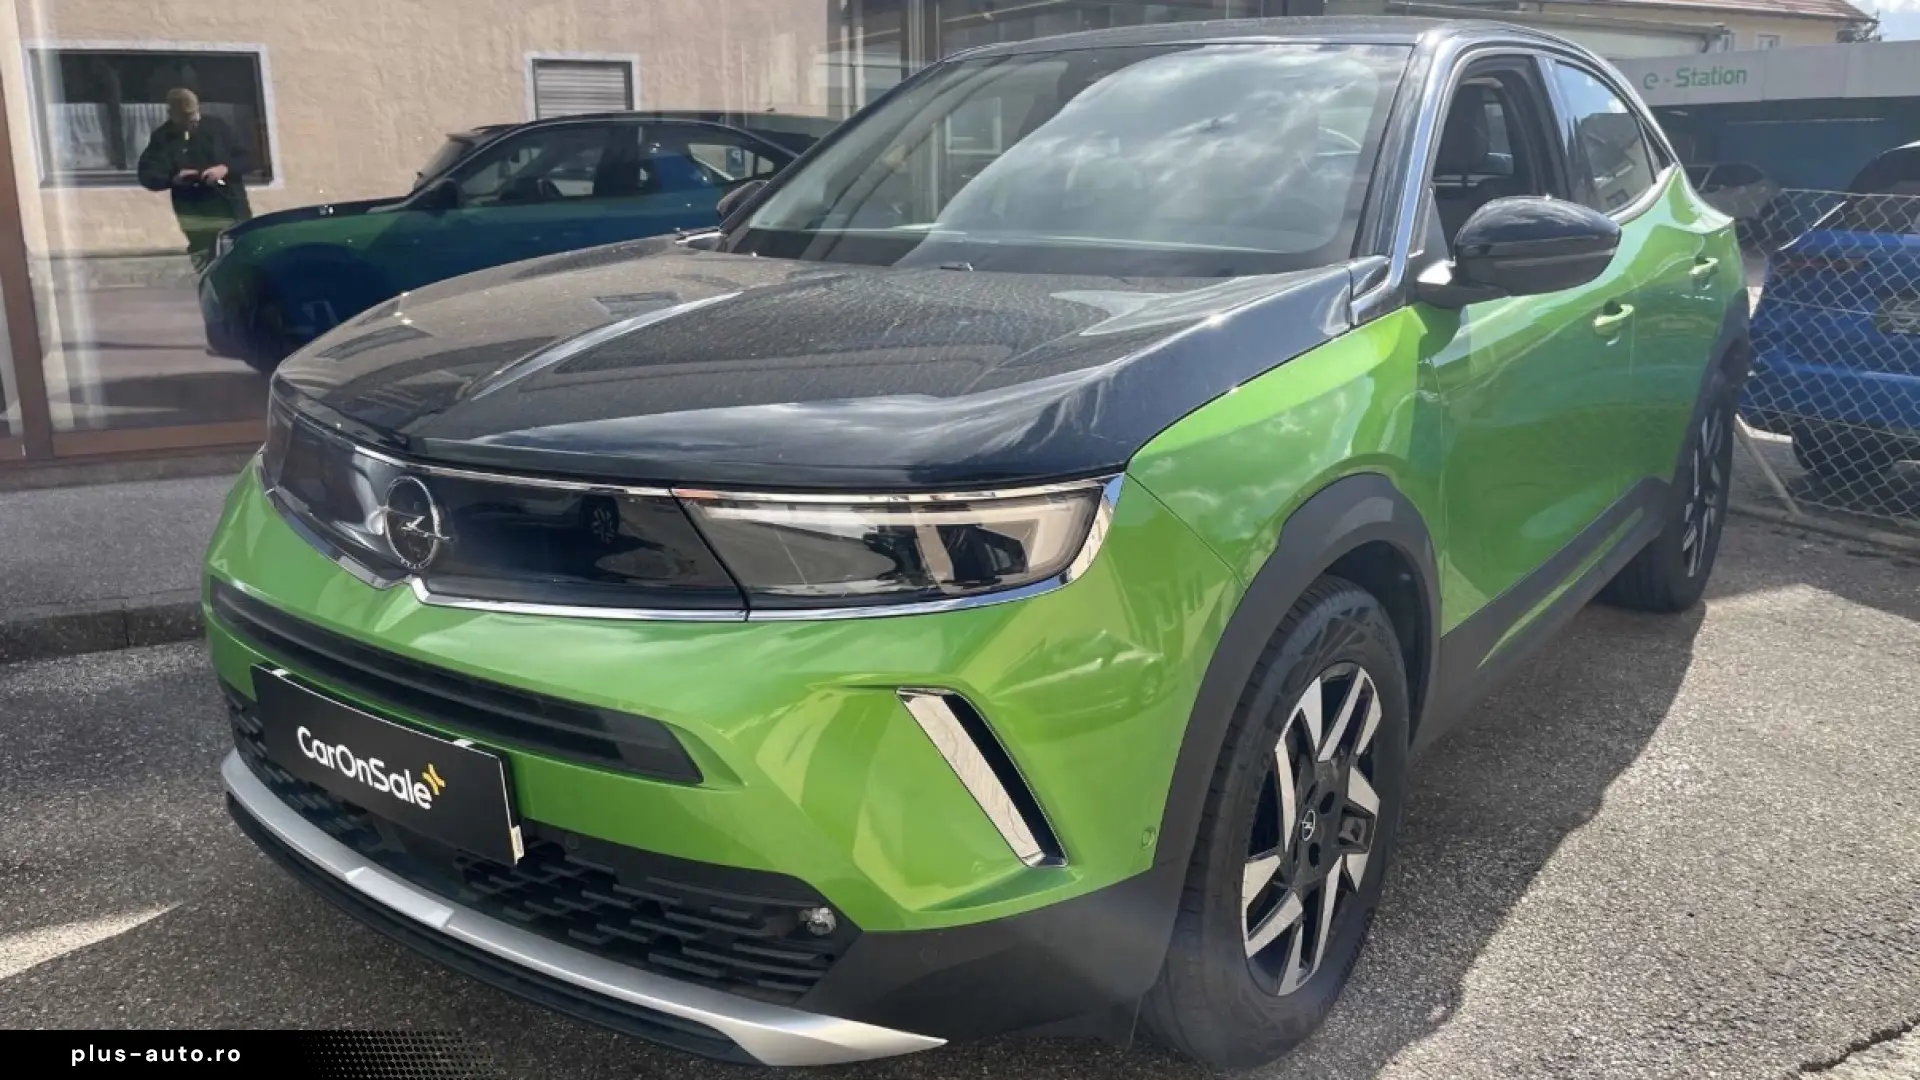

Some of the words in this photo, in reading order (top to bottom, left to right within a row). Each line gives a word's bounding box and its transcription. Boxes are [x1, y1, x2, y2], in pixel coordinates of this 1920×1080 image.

[1643, 72, 1659, 90] e
[1675, 65, 1748, 88] Station
[296, 725, 433, 810] CarOnSale
